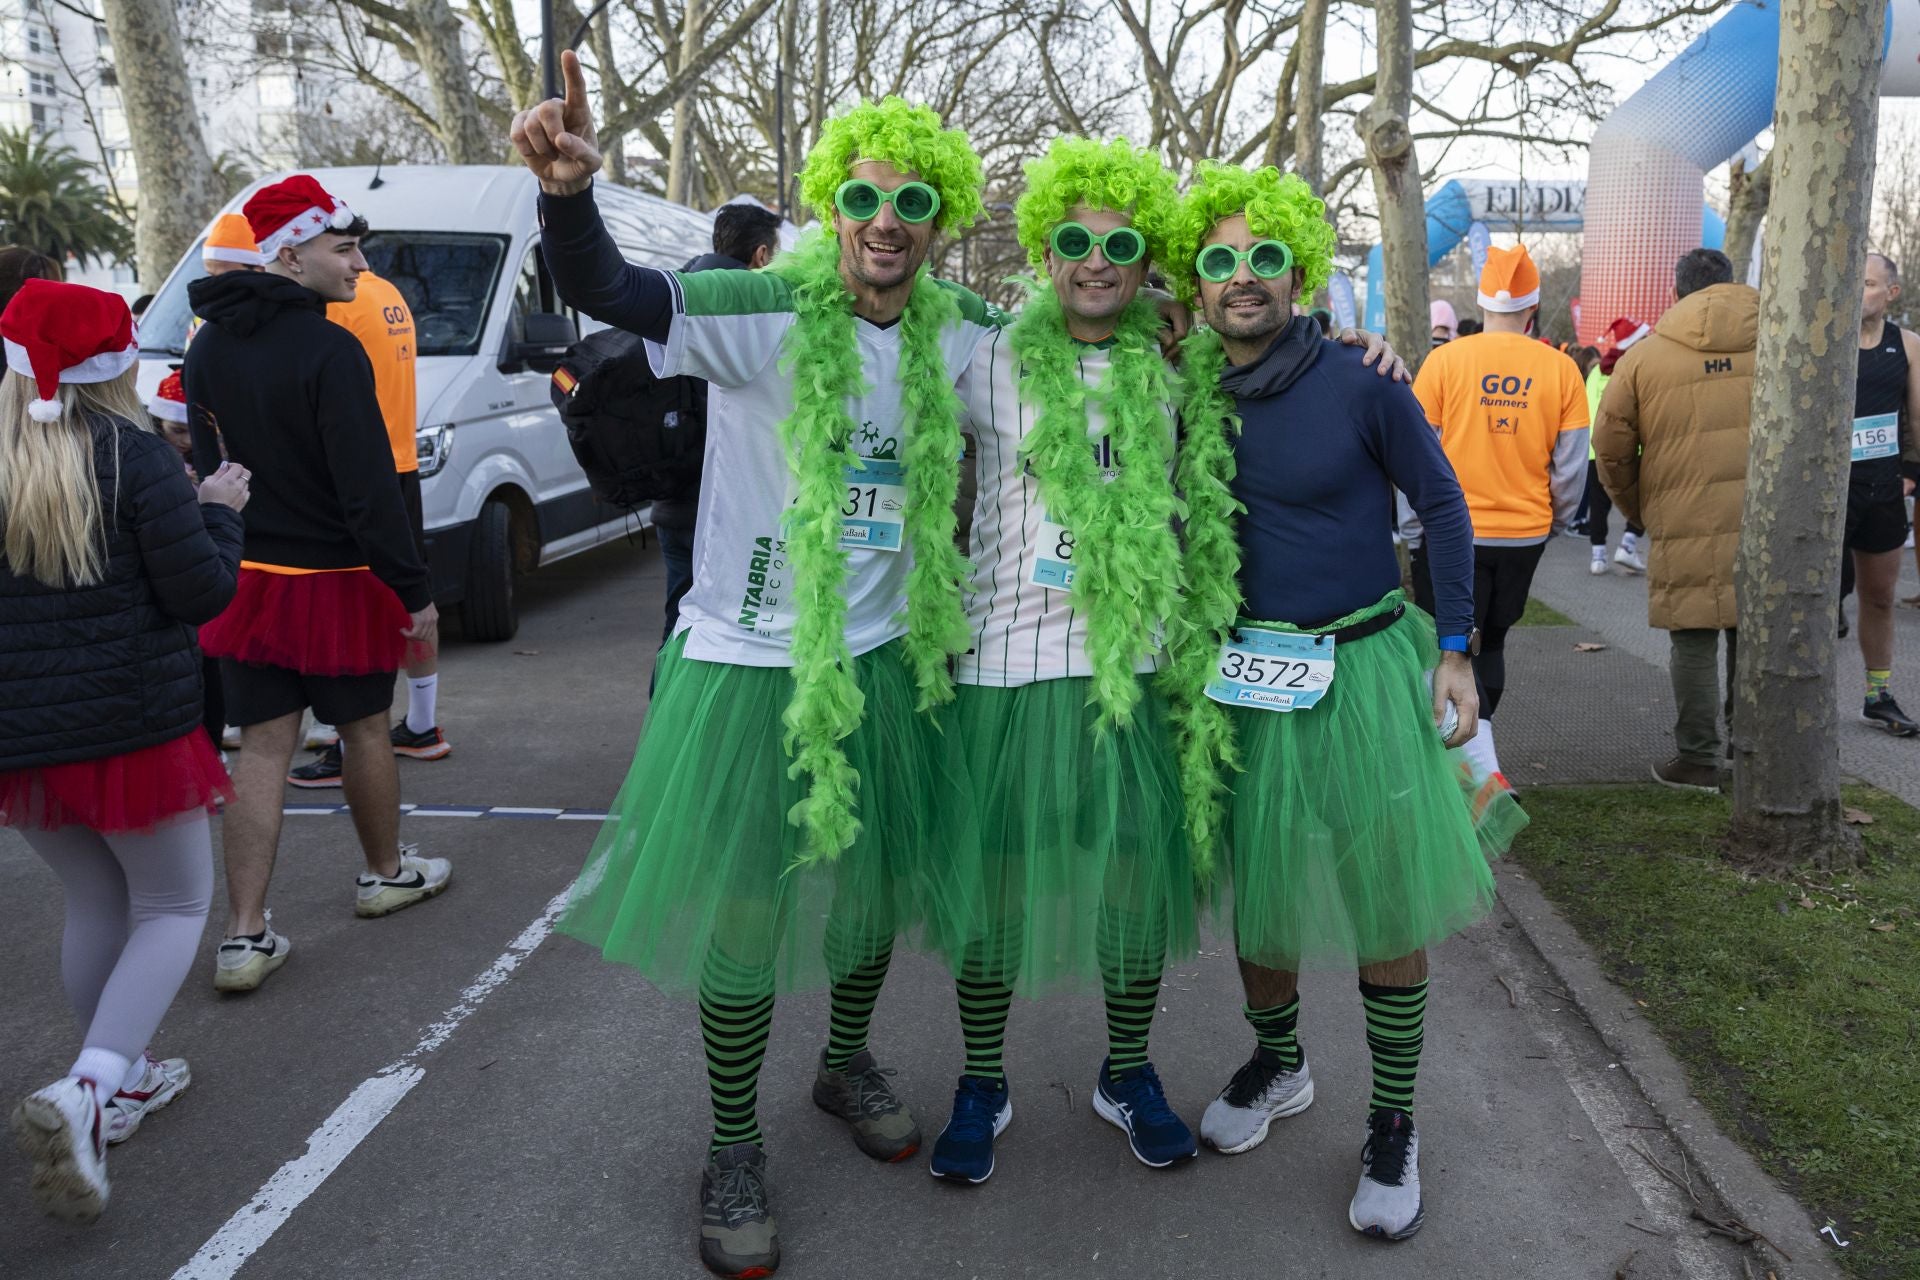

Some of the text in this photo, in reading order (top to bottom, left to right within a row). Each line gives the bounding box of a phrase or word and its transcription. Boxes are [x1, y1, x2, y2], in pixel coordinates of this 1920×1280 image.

[1486, 186, 1530, 213] EL
[1704, 358, 1732, 374] HH
[1481, 374, 1533, 396] GO!
[1480, 396, 1528, 409] Runners
[841, 486, 878, 518] 31
[1221, 652, 1310, 688] 3572
[1252, 691, 1291, 706] CaixaBank
